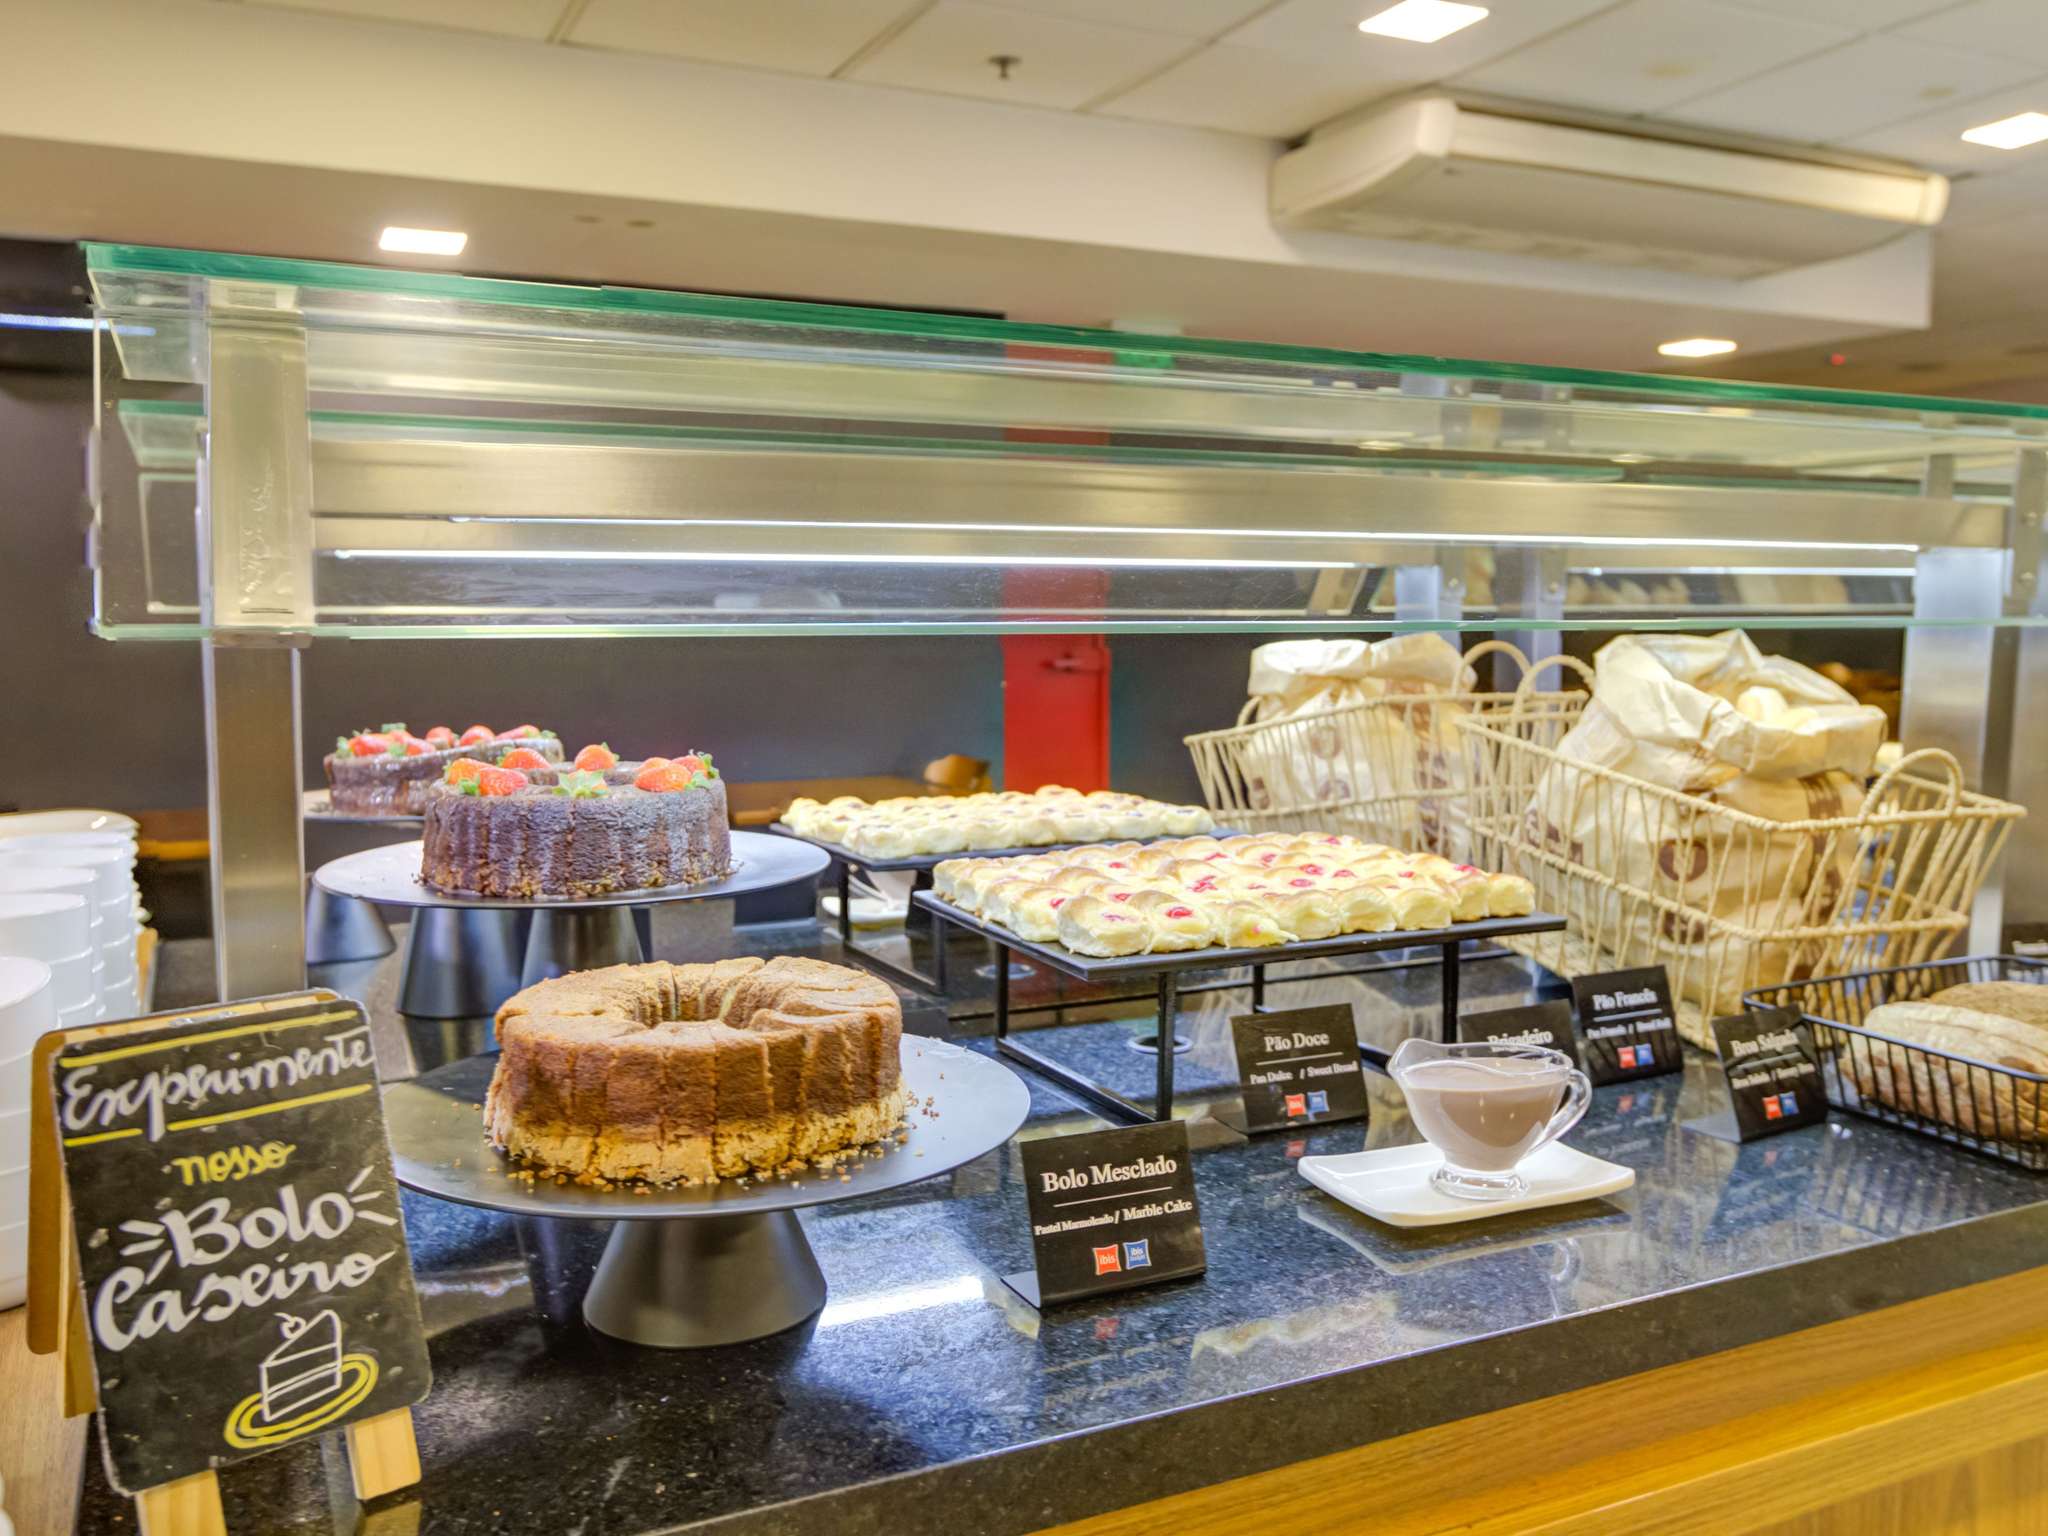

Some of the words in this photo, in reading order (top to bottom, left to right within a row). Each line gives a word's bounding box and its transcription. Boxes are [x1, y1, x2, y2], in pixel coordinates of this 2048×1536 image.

[1264, 1036, 1291, 1052] Pão
[1293, 1032, 1330, 1047] Doce
[61, 1026, 375, 1142] Experimente
[173, 1142, 296, 1186] nosso
[1040, 1168, 1088, 1193] Bolo
[1089, 1155, 1177, 1186] Mesclado
[160, 1185, 354, 1268] Bolo
[1033, 1221, 1061, 1236] Pastel
[1122, 1203, 1163, 1221] Marble
[1164, 1199, 1193, 1214] Cake
[95, 1250, 396, 1352] Caseiro
